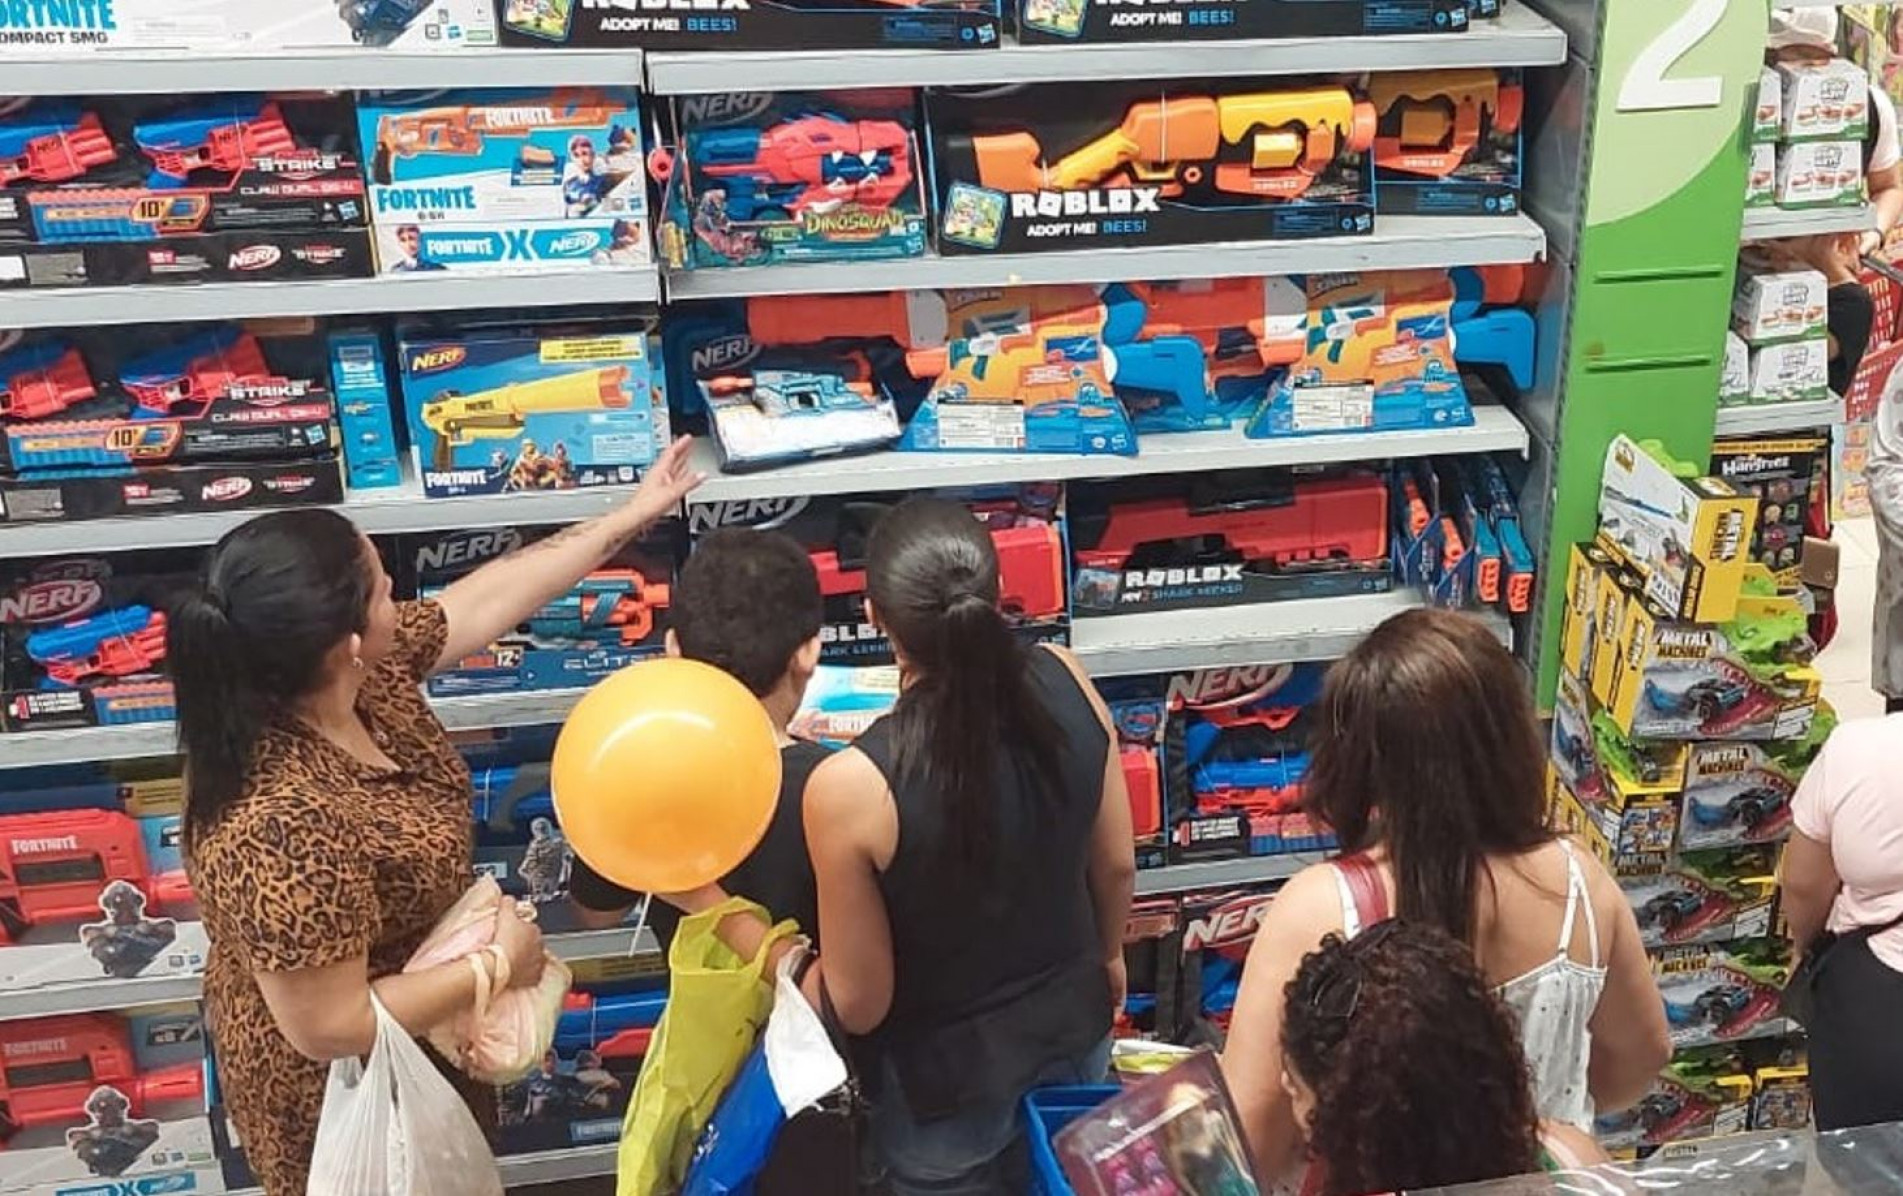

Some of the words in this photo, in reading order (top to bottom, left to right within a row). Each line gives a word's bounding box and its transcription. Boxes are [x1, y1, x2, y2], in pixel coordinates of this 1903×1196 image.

[0, 0, 117, 30] ORTNITE
[600, 17, 650, 31] ADOPT
[686, 16, 738, 31] BEES!
[1110, 12, 1156, 27] ADOPT
[1188, 9, 1234, 25] BEES!
[0, 31, 65, 43] OMPACT
[1614, 0, 1728, 112] 2
[256, 155, 338, 172] STRIKE
[376, 184, 476, 214] FORTNITE
[1011, 188, 1161, 218] ROBLOX
[805, 207, 907, 234] DINOSQUAD
[1026, 222, 1072, 236] ADOPT
[426, 238, 494, 256] FORTNITE
[548, 231, 600, 255] NERF
[228, 245, 281, 270] NERF
[412, 345, 467, 371] NERF
[202, 477, 252, 500] NERF
[426, 469, 488, 488] FORTNITE
[416, 529, 518, 572] NERF
[1125, 564, 1243, 588] ROBLOX
[0, 577, 101, 624] NERF
[820, 624, 888, 642] BLO
[1166, 664, 1286, 707] NERF
[10, 835, 78, 855] FORTNITE
[1183, 904, 1267, 948] NER
